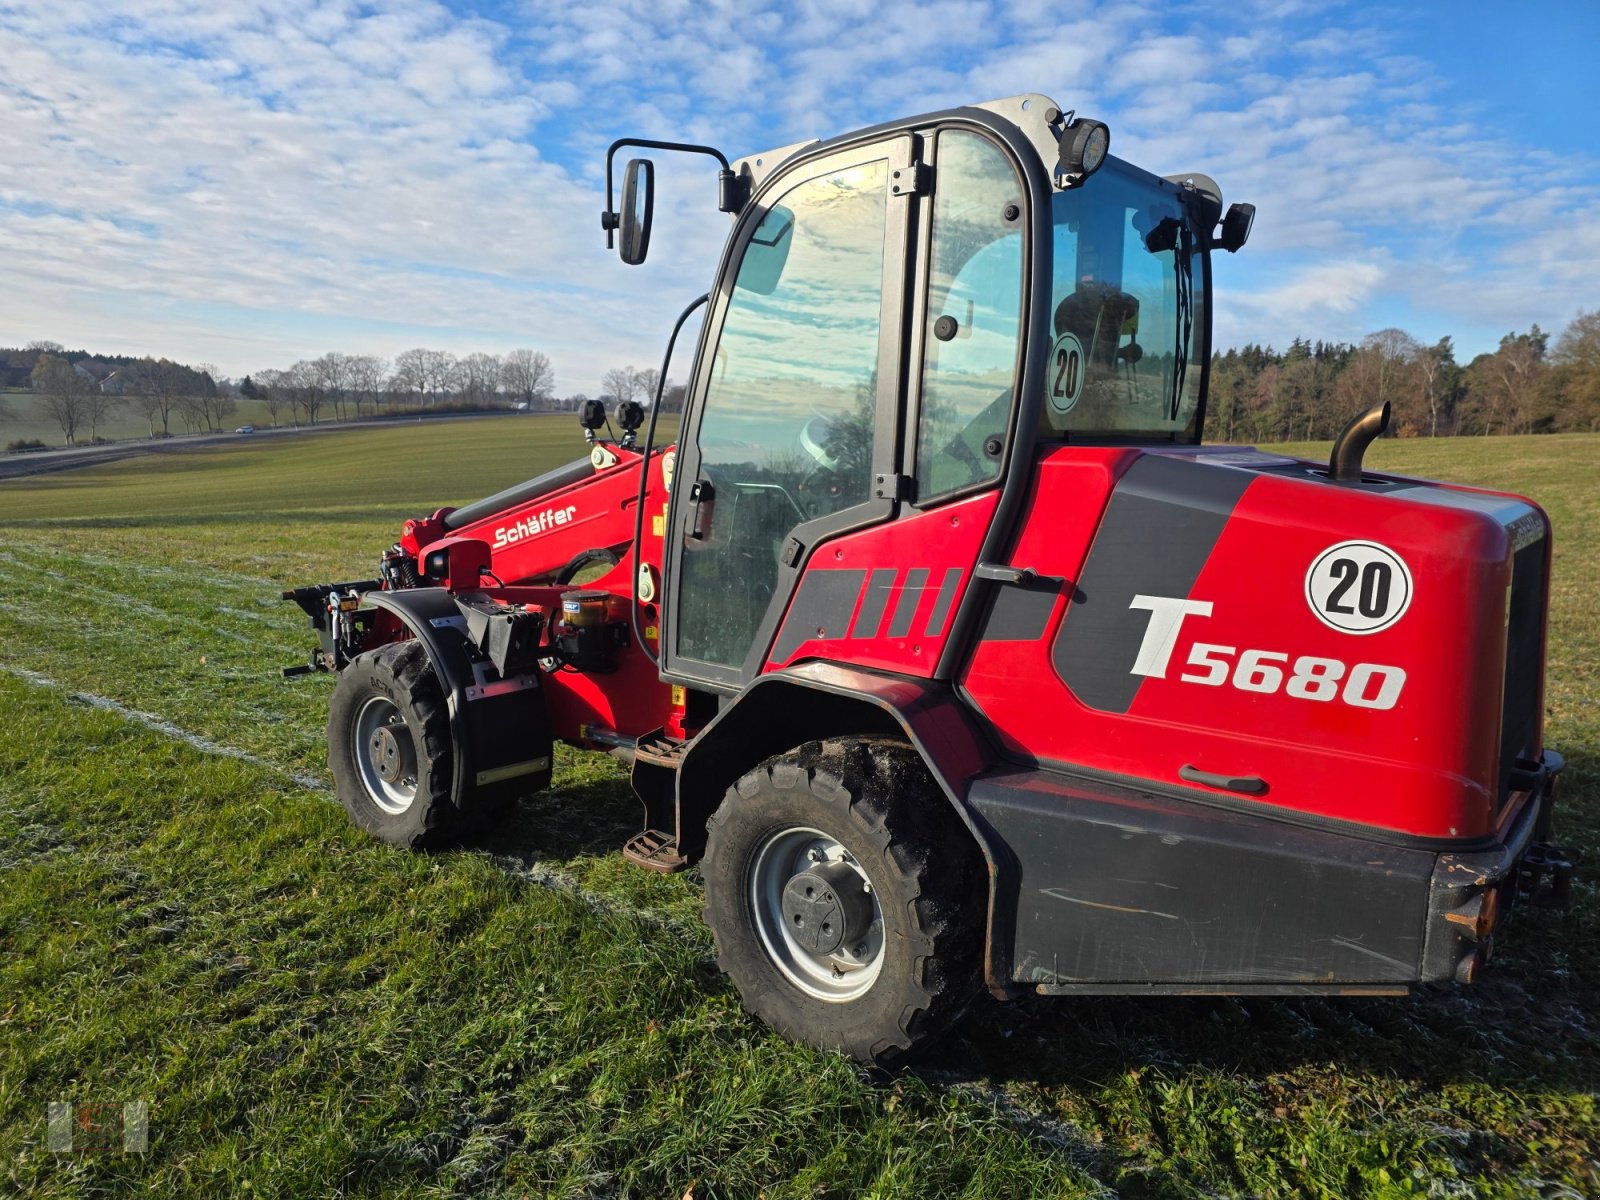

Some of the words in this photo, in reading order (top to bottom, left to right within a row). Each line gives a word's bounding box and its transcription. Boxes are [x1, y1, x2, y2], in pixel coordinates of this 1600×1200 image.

[1053, 348, 1079, 399] 20
[492, 505, 576, 549] Schäffer
[1325, 557, 1392, 619] 20
[370, 676, 394, 699] AC70
